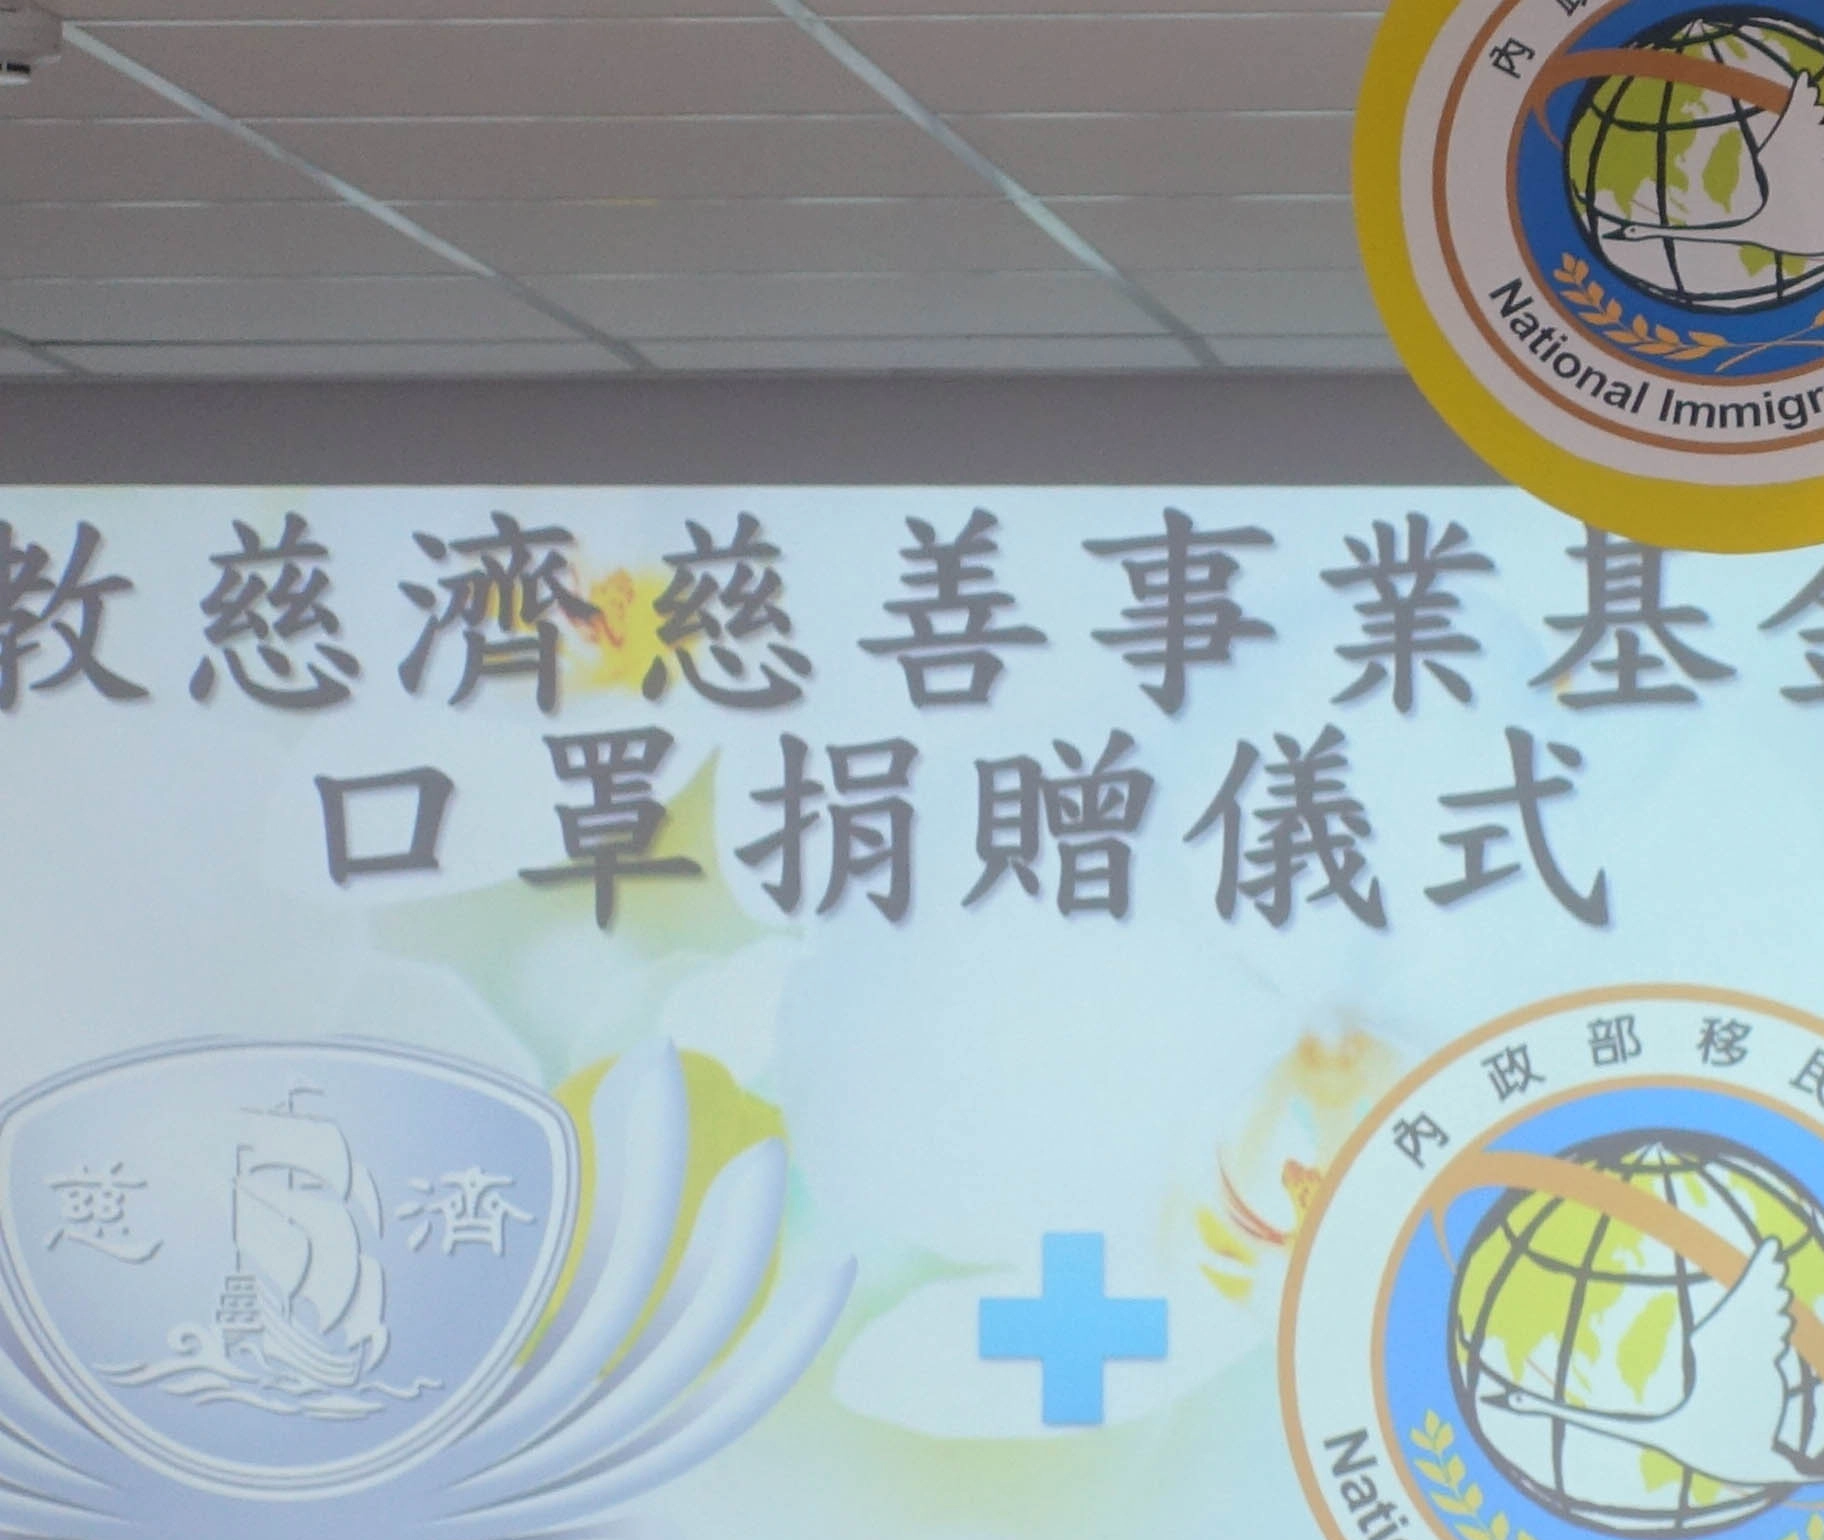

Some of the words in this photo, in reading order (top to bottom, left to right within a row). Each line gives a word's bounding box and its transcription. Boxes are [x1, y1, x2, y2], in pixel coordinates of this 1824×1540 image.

[1489, 277, 1650, 415] National
[312, 724, 1611, 930] 口罩捐贈儀式
